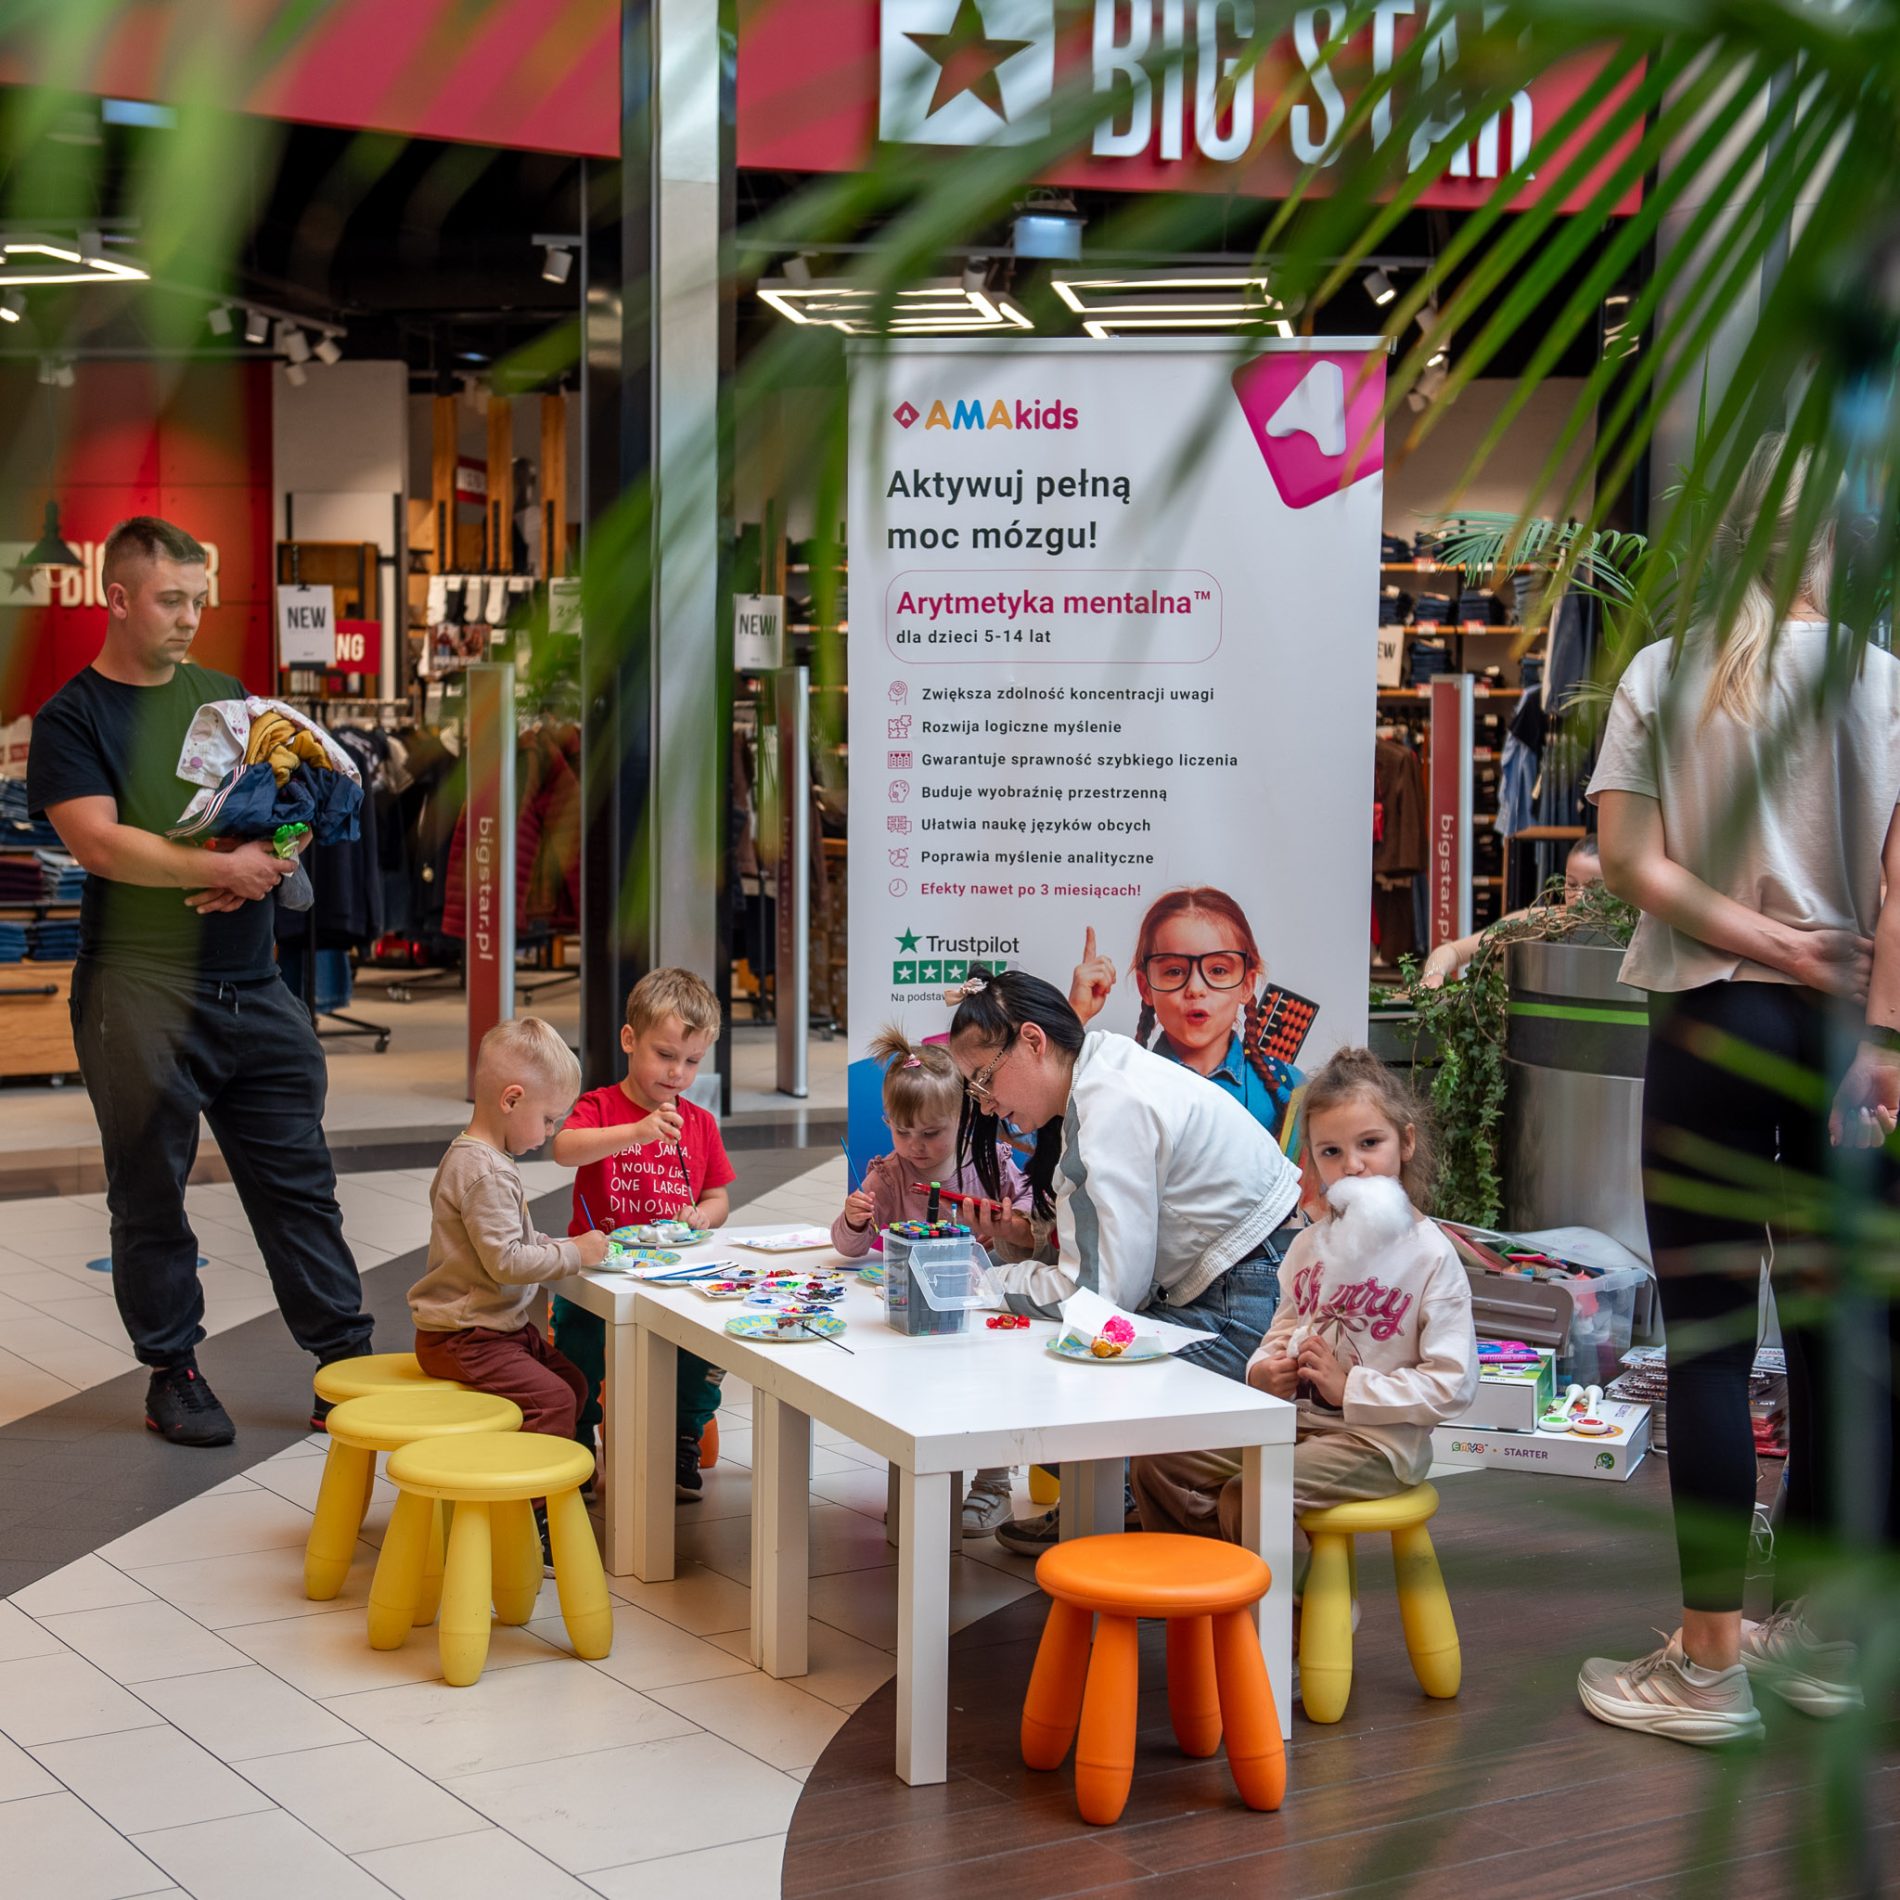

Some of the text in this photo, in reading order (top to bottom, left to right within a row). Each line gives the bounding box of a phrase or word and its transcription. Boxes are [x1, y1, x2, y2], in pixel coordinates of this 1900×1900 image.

[1091, 0, 1255, 161] BIG
[925, 399, 1079, 430] AMAkids
[886, 468, 1131, 505] Aktywuj pełną
[887, 520, 1097, 556] moc mózgu!
[896, 589, 1054, 620] Arytmetyka
[287, 606, 326, 629] NEW
[739, 613, 777, 636] NEW
[896, 629, 1051, 644] dla dzieci 5-14 lat
[1377, 640, 1396, 659] EW
[922, 685, 1214, 703] Zwiększa zdolność koncentracji uwagi
[922, 718, 1122, 736] Rozwija logiczne myślenie
[922, 750, 1238, 769] Gwarantuje sprawność szybkiego liczenia
[922, 783, 1167, 802] Buduje wyobraźnię przestrzenną
[921, 816, 1151, 834] Ułatwia naukę języków obcych
[921, 849, 1154, 867] Poprawia myślenie analityczne
[476, 817, 494, 961] bigstar.pl
[1438, 814, 1454, 945] bigstar.p
[921, 881, 1141, 899] Efekty nawet po 3 miesiącach!
[926, 935, 1020, 956] Trustpilot
[891, 993, 905, 1002] Na
[613, 1162, 616, 1175] I
[621, 1162, 665, 1175] WOULD
[610, 1177, 688, 1196] ONE LARGE
[1504, 1447, 1548, 1459] STARTER
